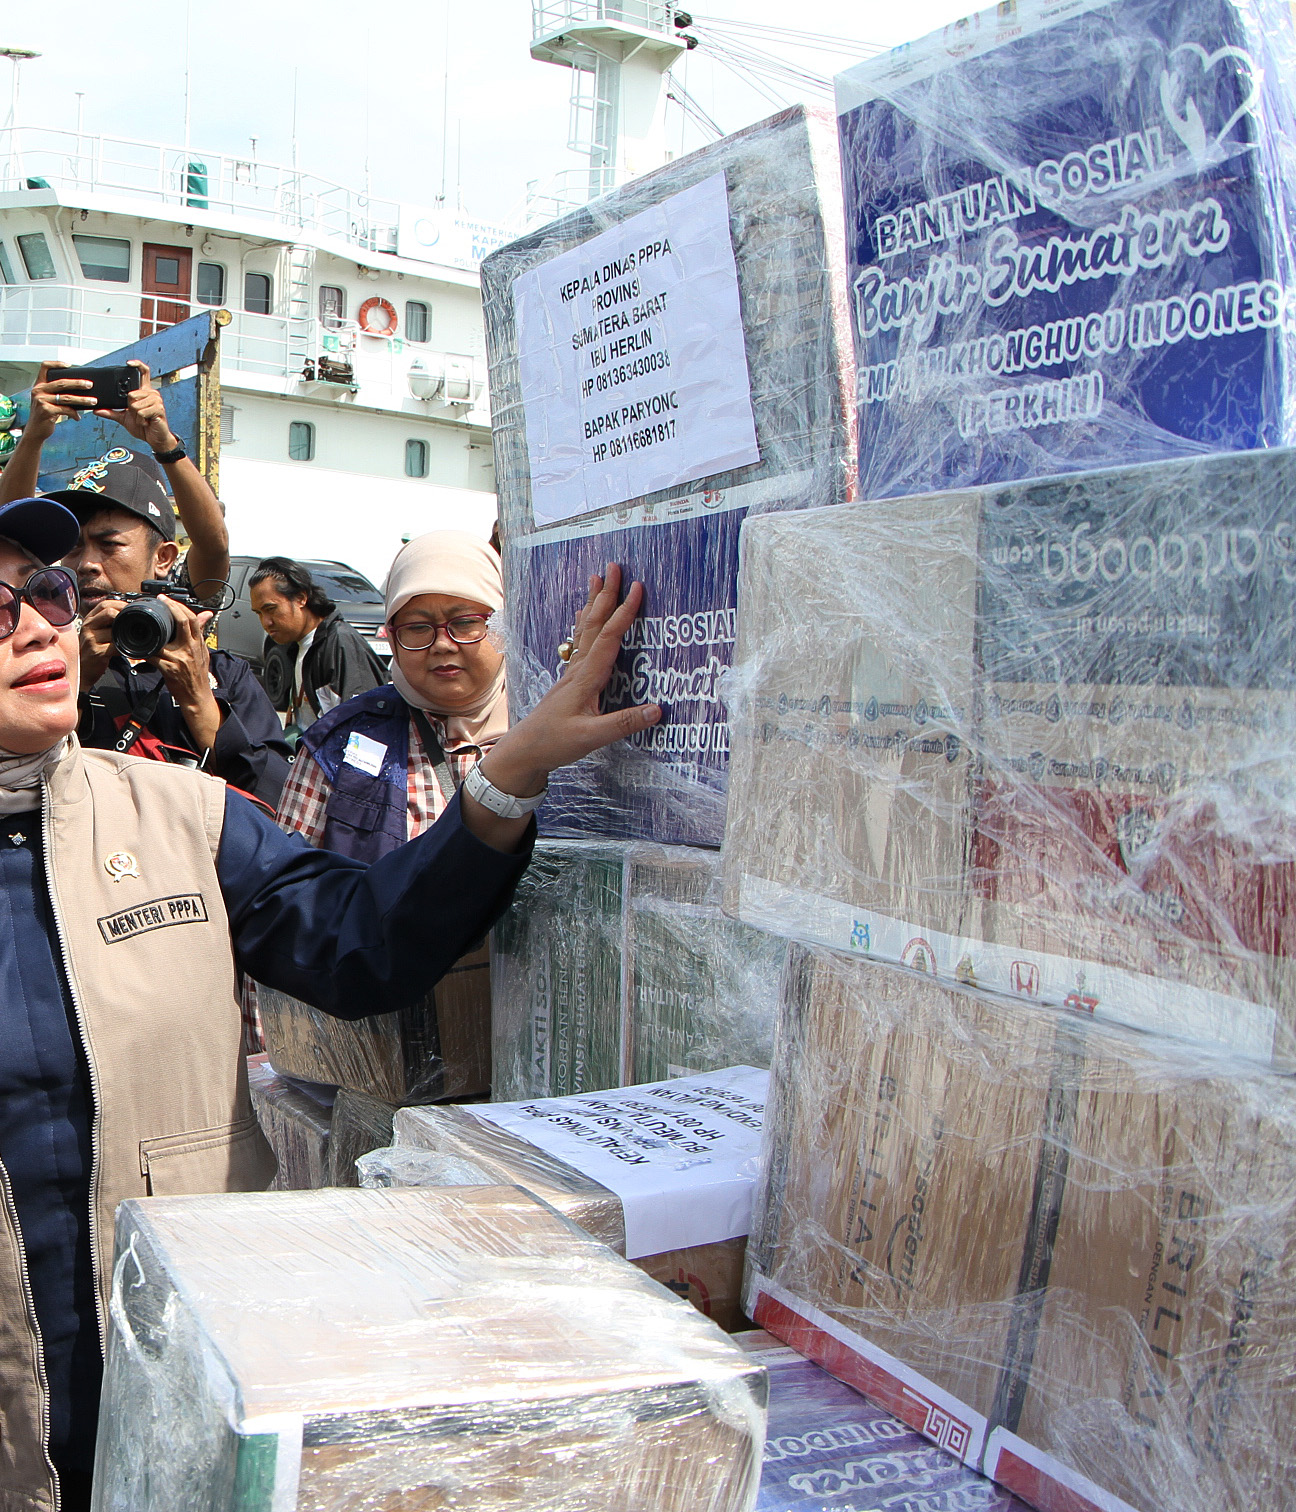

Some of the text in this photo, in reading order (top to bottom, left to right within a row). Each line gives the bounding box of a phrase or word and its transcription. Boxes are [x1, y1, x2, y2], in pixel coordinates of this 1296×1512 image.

[875, 127, 1174, 259] BANTUAN SOSIAL
[455, 220, 519, 239] KEMENTERIAN
[472, 234, 505, 247] KAPA
[454, 258, 480, 269] POLIT
[980, 198, 1230, 307] Sumatera
[560, 238, 672, 303] KEPALA DINAS PPPA
[571, 292, 668, 351] SUMATERA BARAT
[946, 280, 1282, 377] KHONGHUCU INDONES
[591, 328, 652, 368] IBU HERLIN
[581, 378, 594, 399] HP
[958, 370, 1104, 438] (PERKHIN)
[584, 410, 618, 440] BAPAK
[593, 420, 676, 464] HP 08116681817
[880, 703, 912, 717] Formula
[1002, 699, 1043, 715] Formula
[116, 730, 133, 750] SO
[1048, 759, 1090, 777] Formula
[1111, 762, 1157, 783] Formula
[107, 898, 200, 938] MENTERI PPPA
[558, 1013, 568, 1089] KORBAN
[574, 1044, 586, 1092] VINSI
[548, 1114, 595, 1139] DINAS
[694, 1128, 725, 1141] HP
[588, 1136, 649, 1166] KEPALA
[680, 1141, 712, 1154] IBU
[1028, 1213, 1049, 1288] INDONESIA
[1144, 1186, 1175, 1303] BERSIH DENGAN
